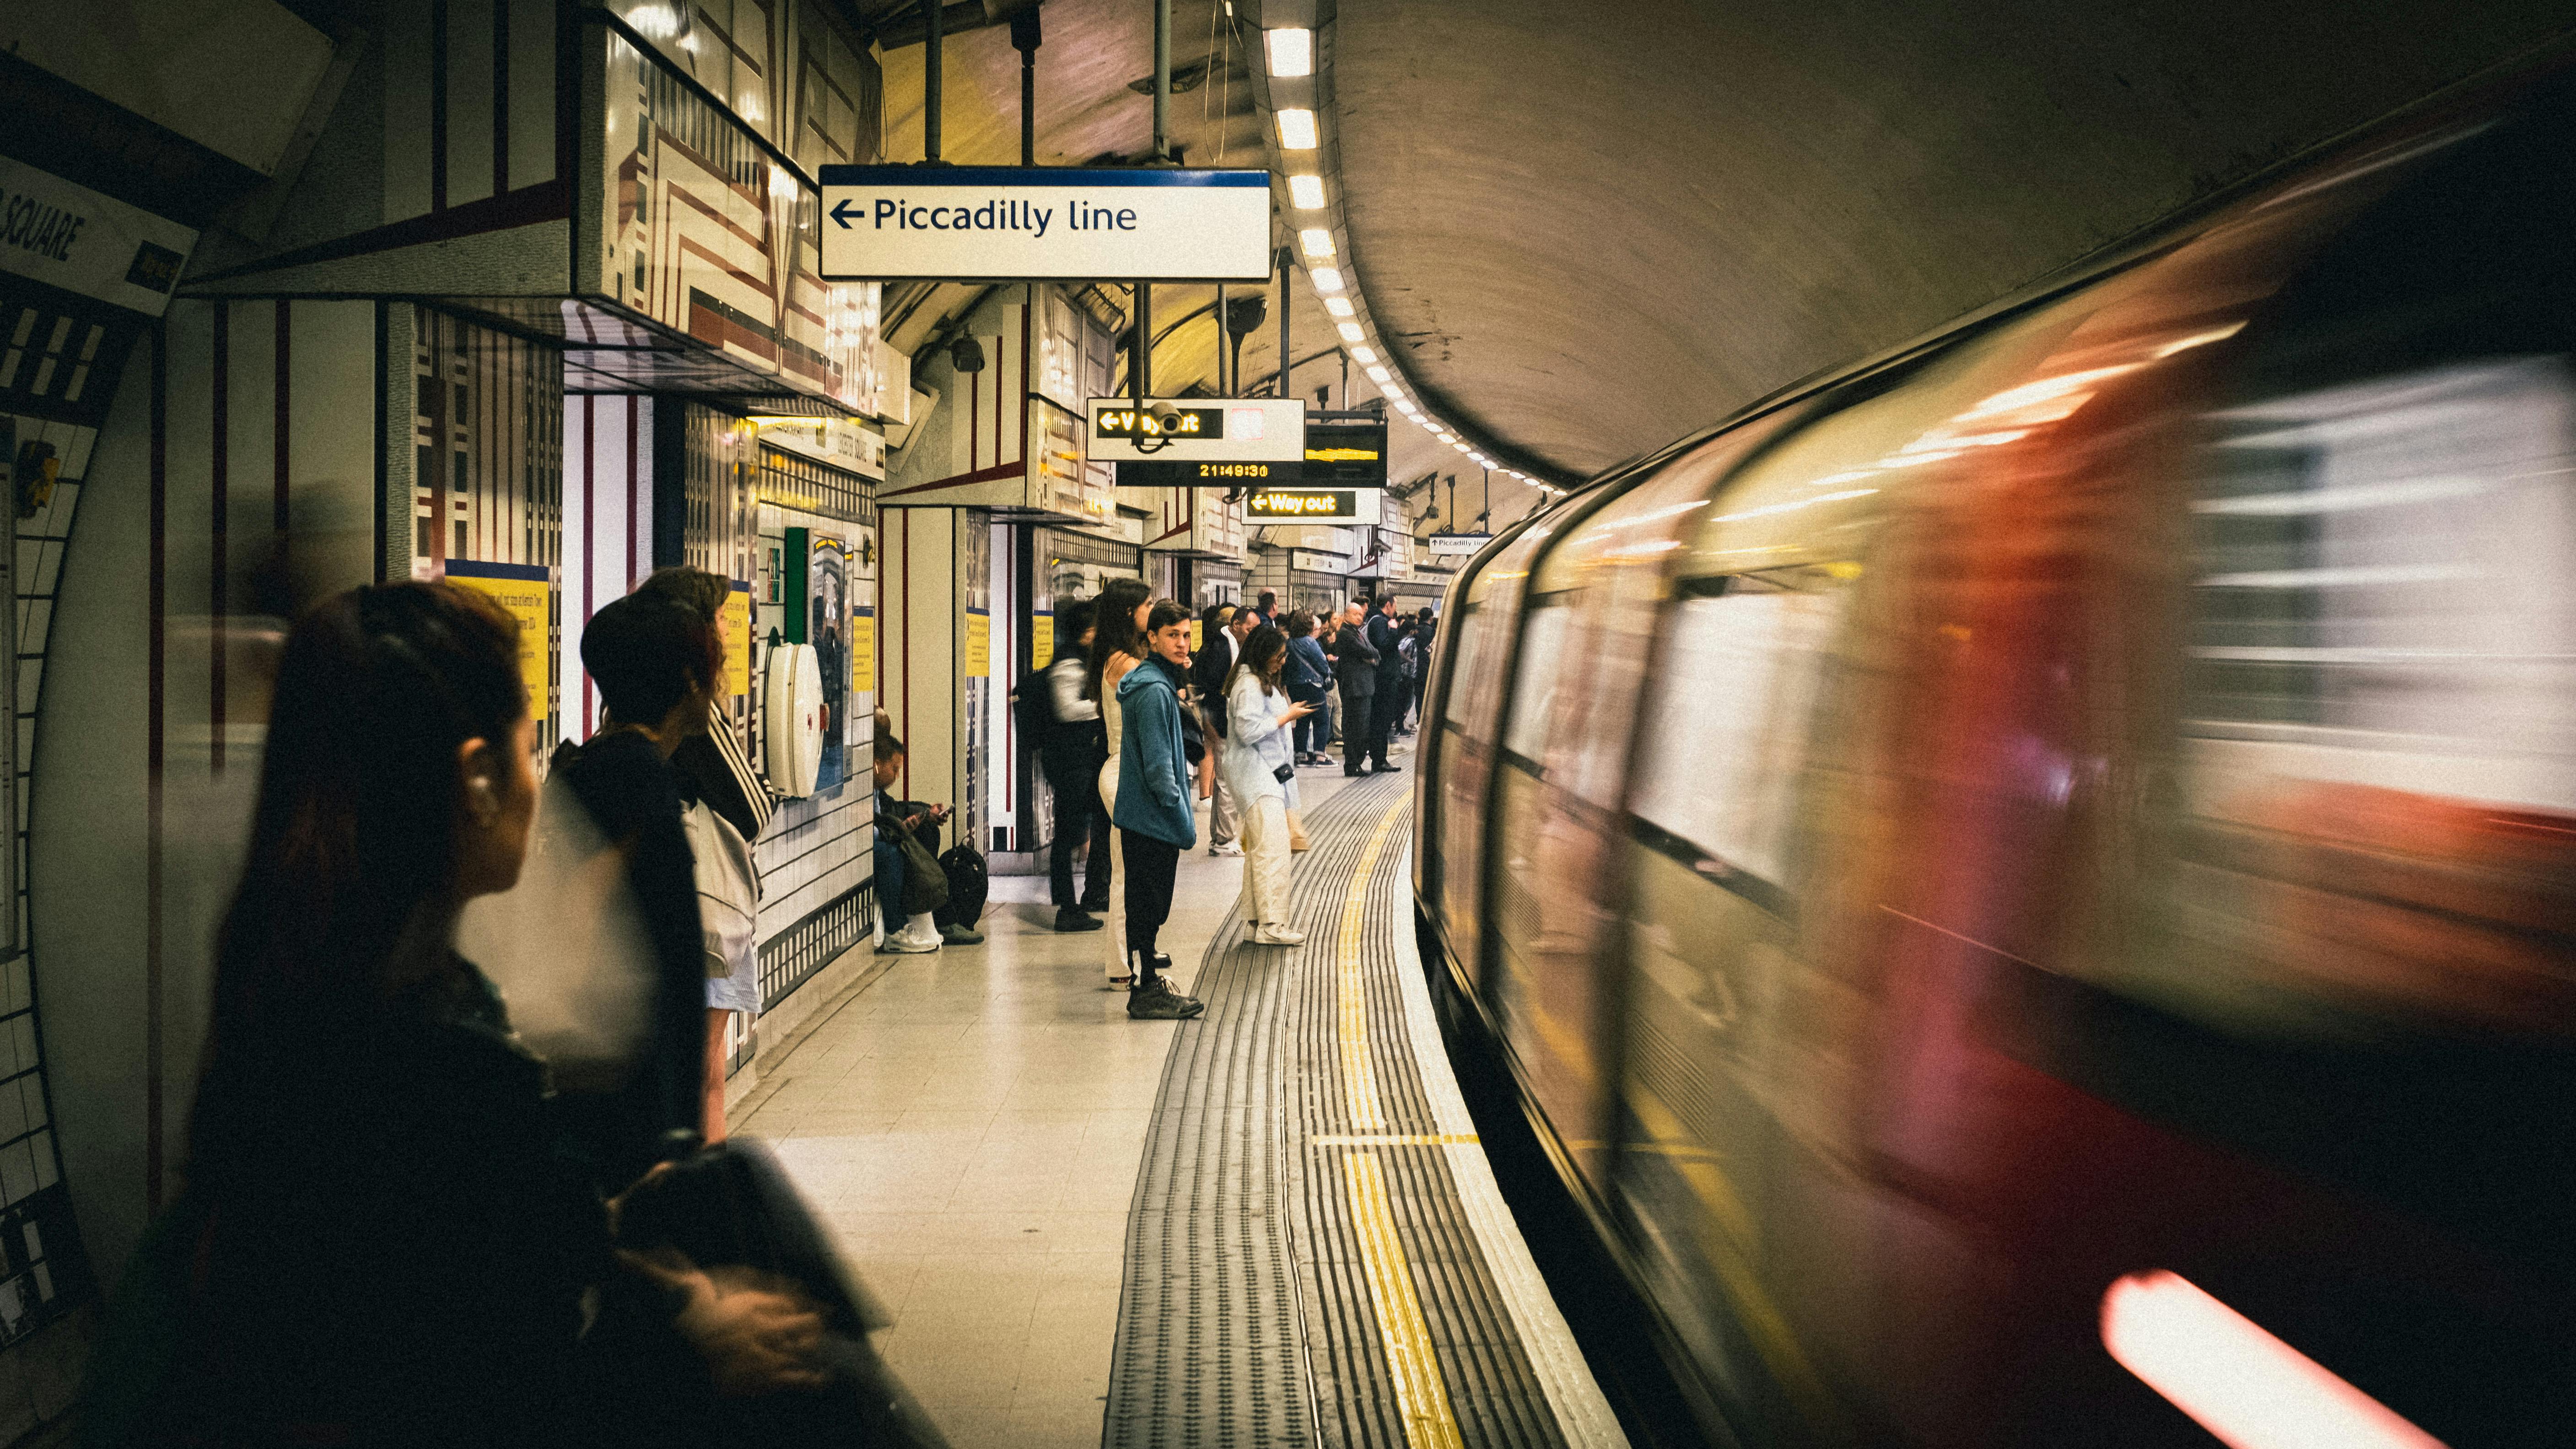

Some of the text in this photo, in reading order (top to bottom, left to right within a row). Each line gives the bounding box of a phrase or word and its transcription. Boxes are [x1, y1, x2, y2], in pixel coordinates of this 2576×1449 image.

[0, 194, 85, 261] SQUARE
[874, 199, 1137, 237] Piccadilly line
[1268, 494, 1337, 513] Way out
